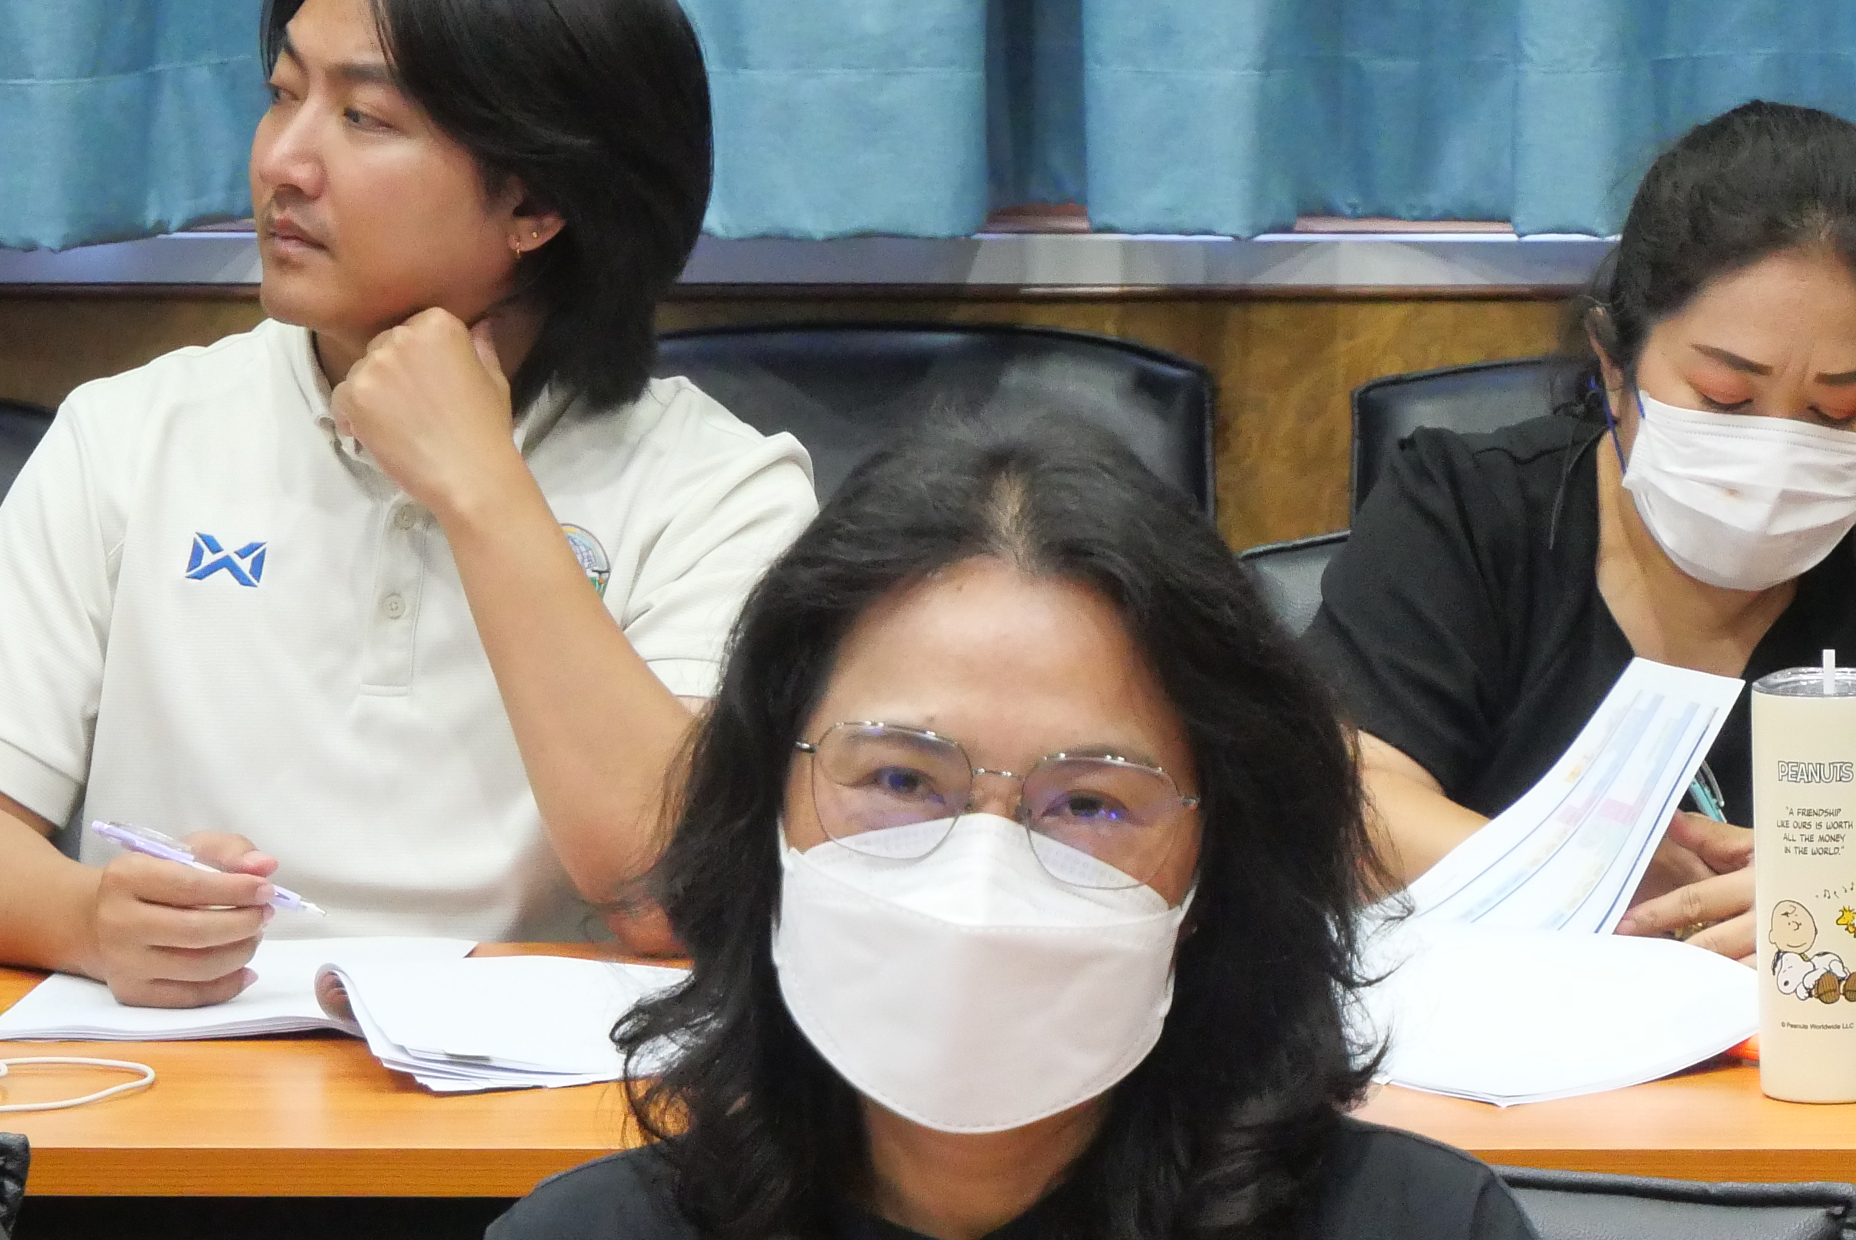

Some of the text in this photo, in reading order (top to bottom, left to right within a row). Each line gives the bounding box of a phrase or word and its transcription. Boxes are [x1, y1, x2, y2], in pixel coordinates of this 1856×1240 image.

[1777, 760, 1854, 783] PEANUTS
[1797, 808, 1841, 817] FRIENDSHIP
[1776, 820, 1853, 830] LIKE OURS IS WORTH
[1783, 833, 1846, 843] ALL THE MONEY
[1784, 846, 1791, 854] IN
[1794, 846, 1808, 855] THE
[1842, 1022, 1854, 1030] LLC
